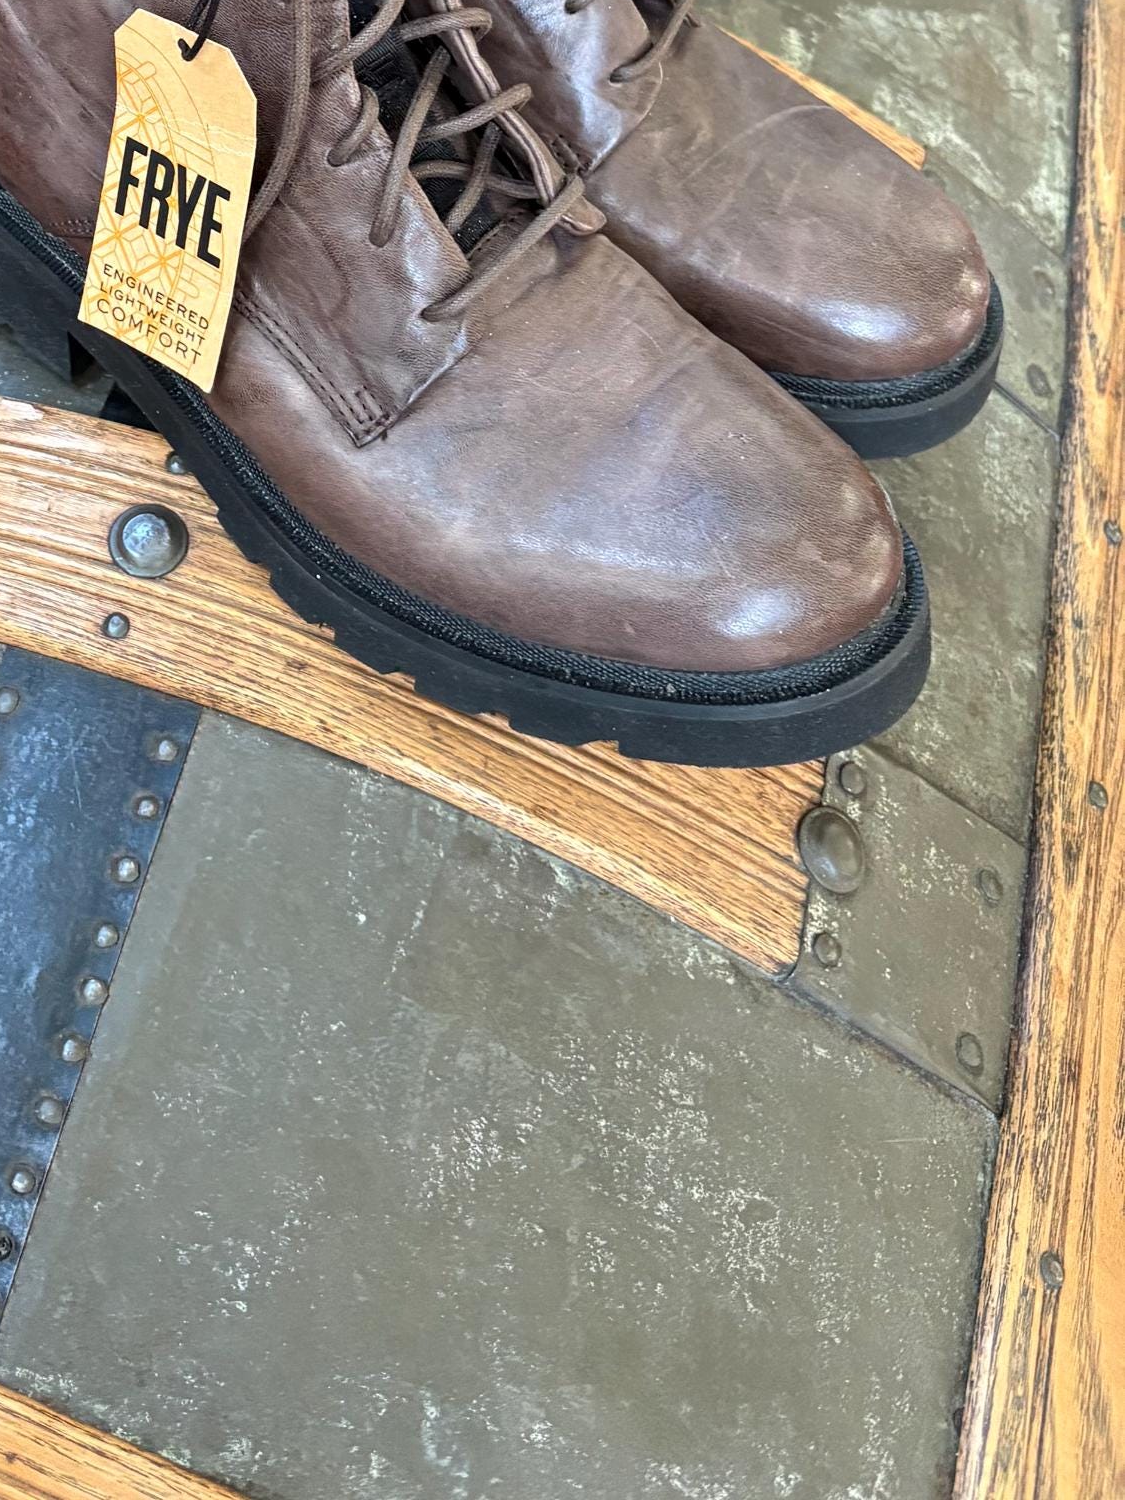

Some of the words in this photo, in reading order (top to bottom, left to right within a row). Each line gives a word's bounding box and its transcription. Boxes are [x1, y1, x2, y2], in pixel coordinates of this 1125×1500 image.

[114, 137, 231, 268] FRYE
[100, 282, 205, 346] LIGHTWEIGHT
[103, 264, 210, 330] ENGINEERED
[96, 299, 202, 365] COMFORT
